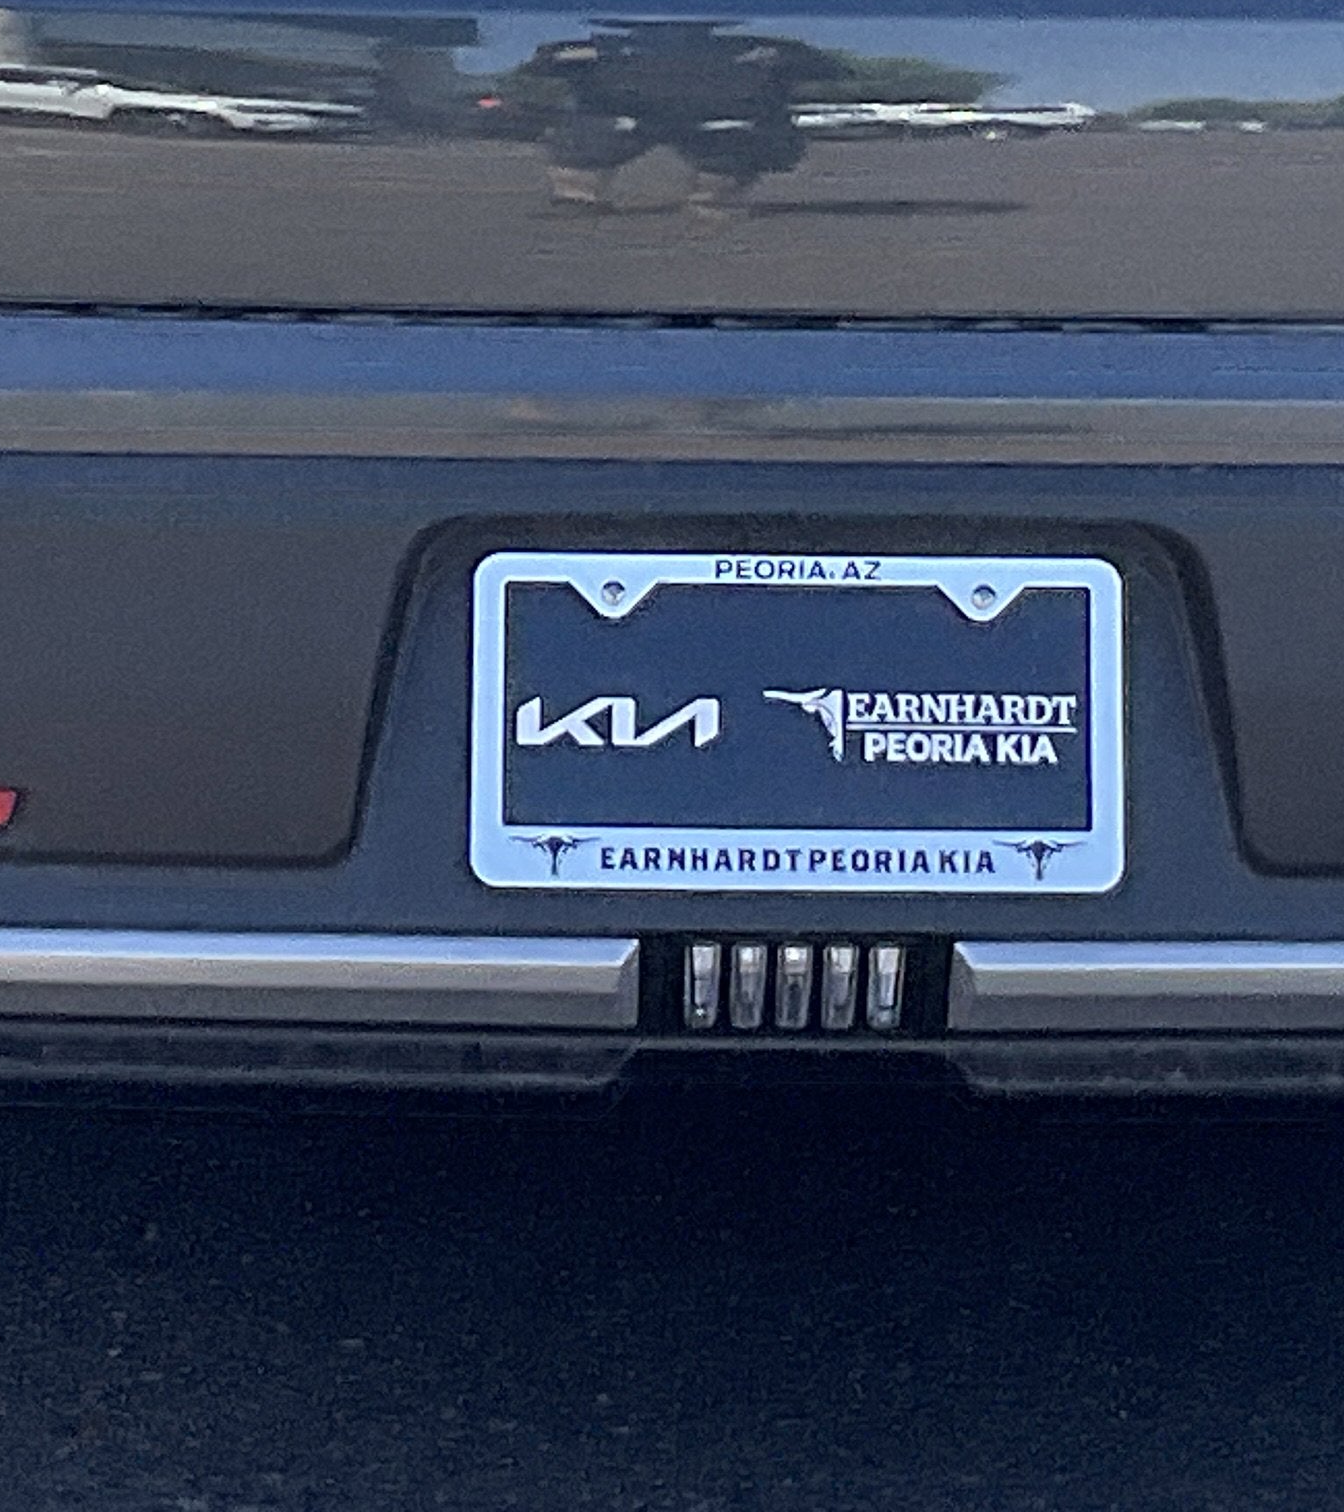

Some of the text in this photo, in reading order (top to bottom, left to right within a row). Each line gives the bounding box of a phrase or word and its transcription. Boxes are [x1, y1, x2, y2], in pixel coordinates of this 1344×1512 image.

[516, 696, 720, 748] KIA
[846, 692, 1077, 725] EARNHARDT
[864, 732, 1058, 764] PEORIA KIA
